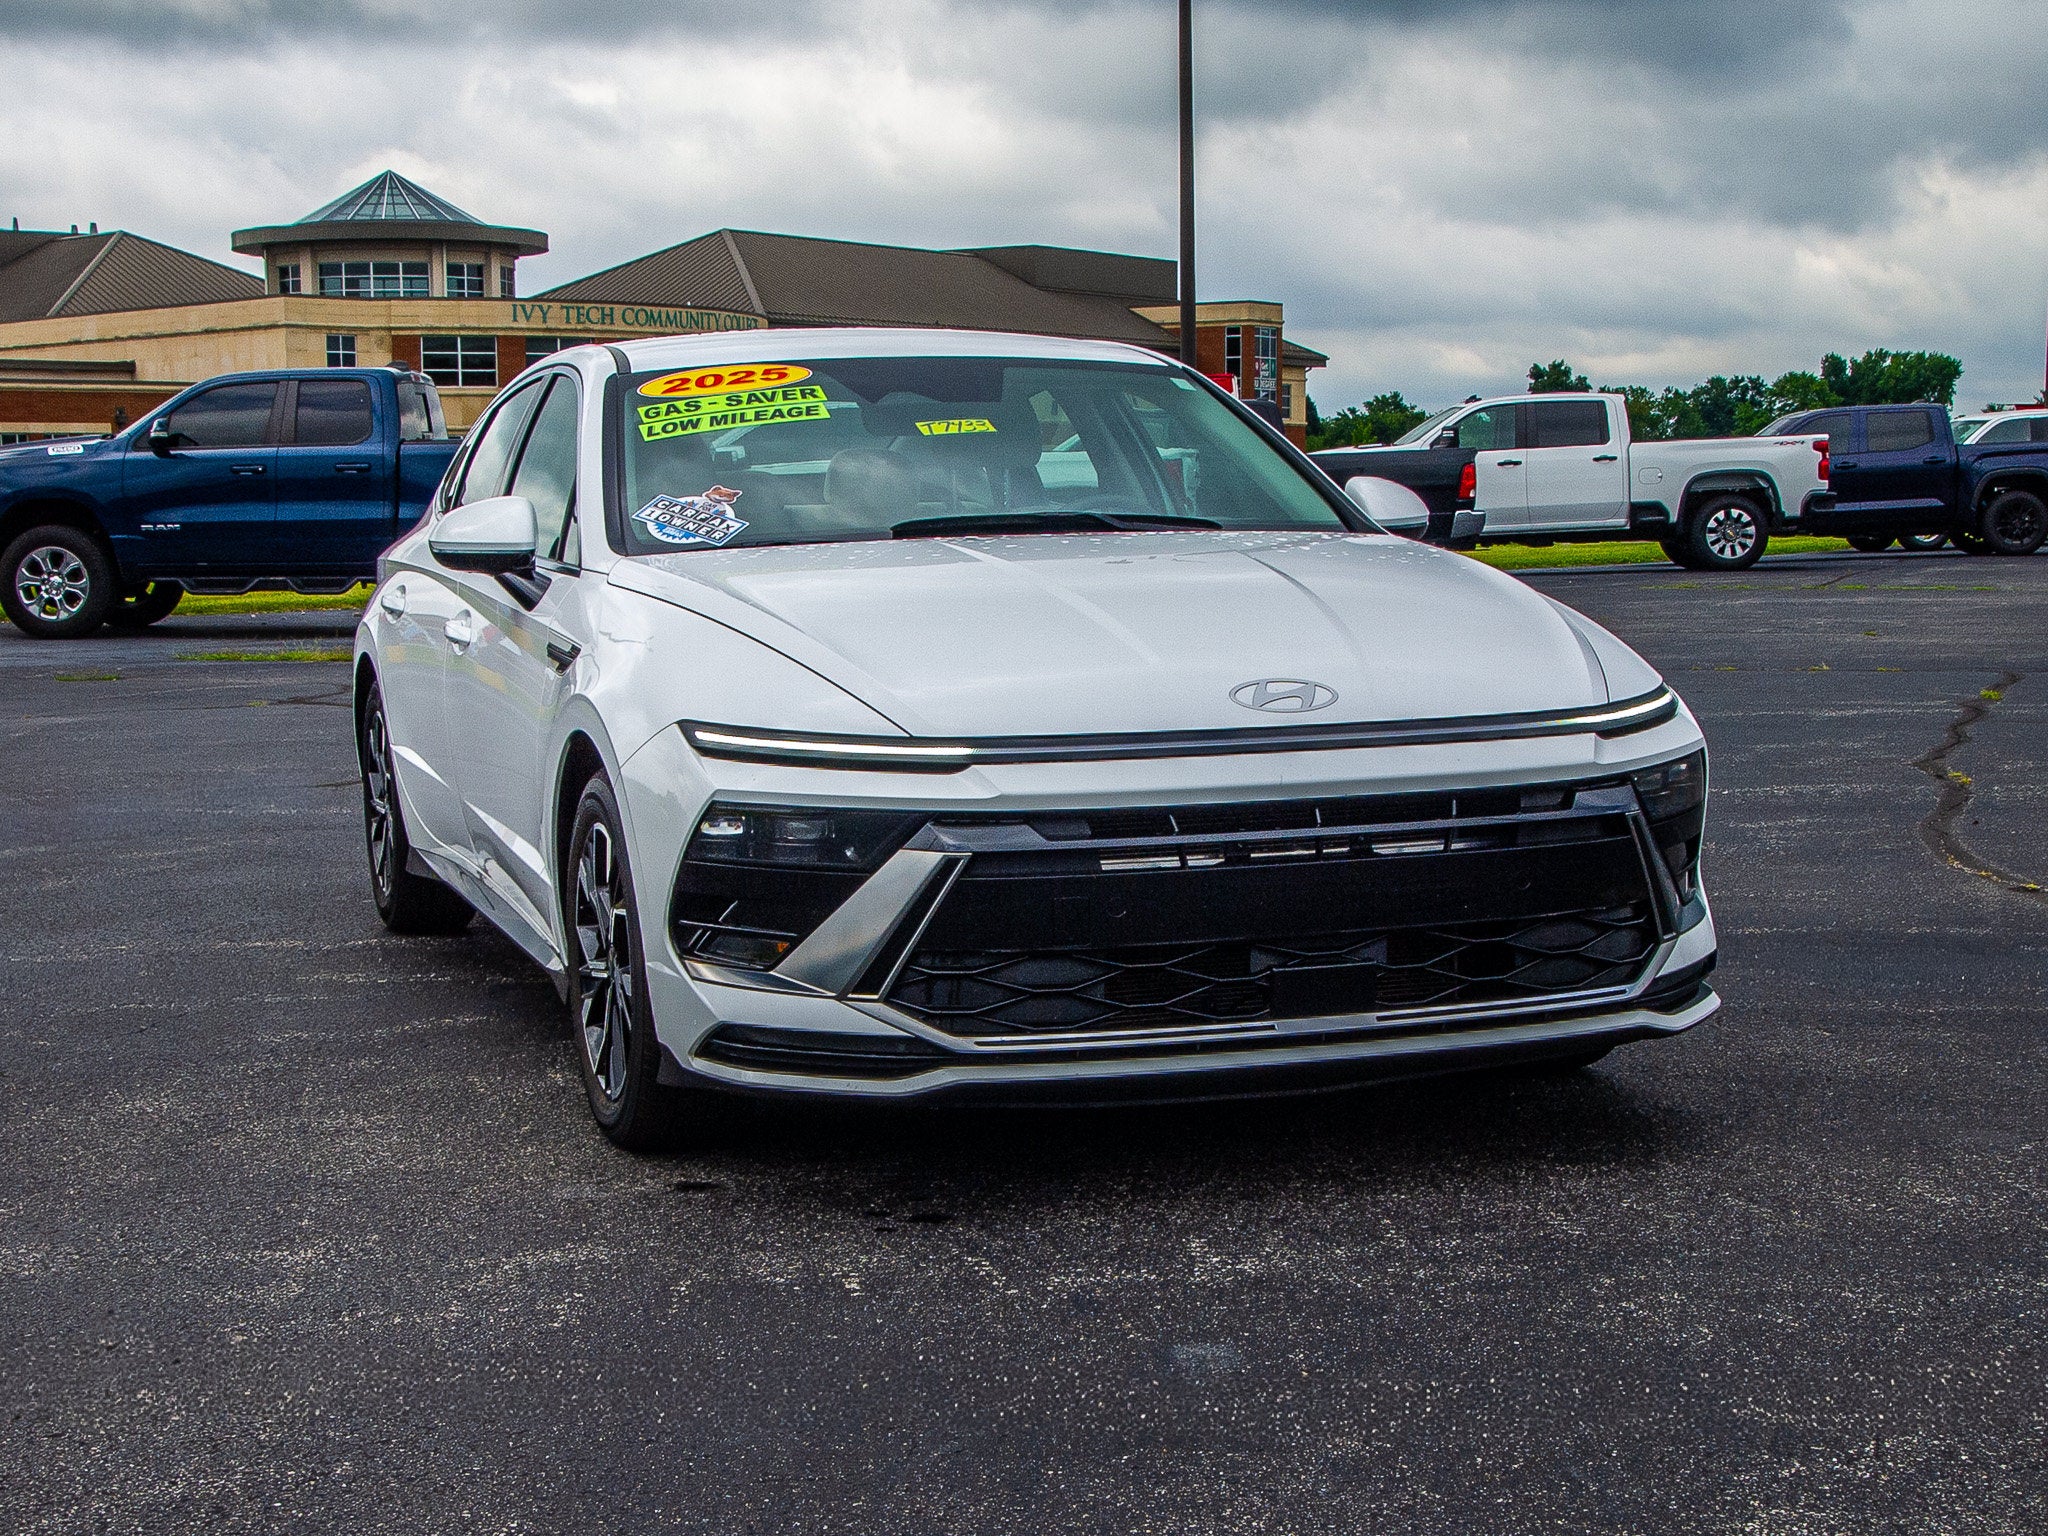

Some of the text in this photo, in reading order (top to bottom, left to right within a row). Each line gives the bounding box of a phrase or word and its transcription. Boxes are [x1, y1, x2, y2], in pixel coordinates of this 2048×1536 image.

[511, 303, 553, 324] IVY
[560, 304, 615, 326] TECH
[621, 307, 721, 331] COMMUNITY
[661, 367, 790, 395] 2025
[644, 400, 702, 420] GAS
[725, 387, 822, 407] SAVER
[646, 404, 821, 438] LOW MILEAGE
[656, 500, 735, 532] CARFAX
[657, 513, 725, 540] OWNER
